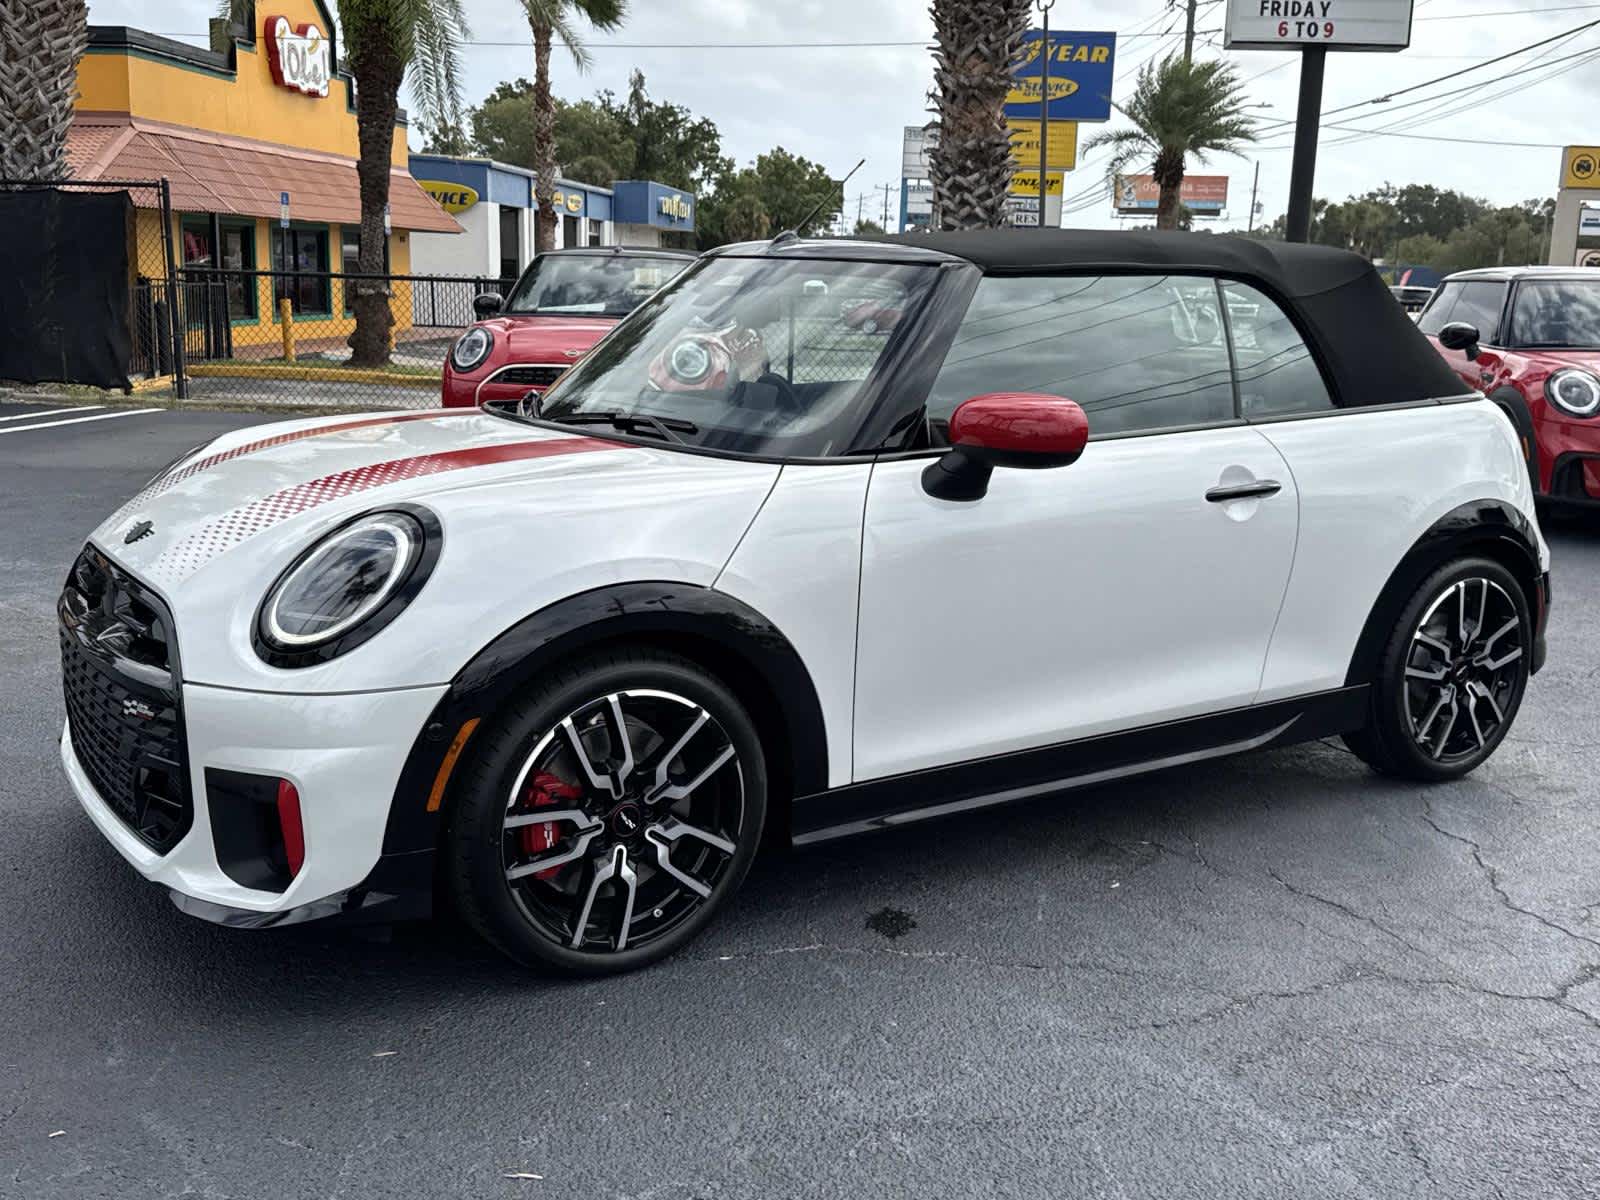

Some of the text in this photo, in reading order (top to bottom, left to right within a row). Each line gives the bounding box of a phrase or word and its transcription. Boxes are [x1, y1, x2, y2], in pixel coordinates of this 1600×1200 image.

[1260, 0, 1331, 17] FRIDAY
[1278, 21, 1334, 38] 6 TO 9
[1046, 44, 1109, 63] YEAR
[431, 191, 469, 206] VICE
[1015, 214, 1038, 224] RES
